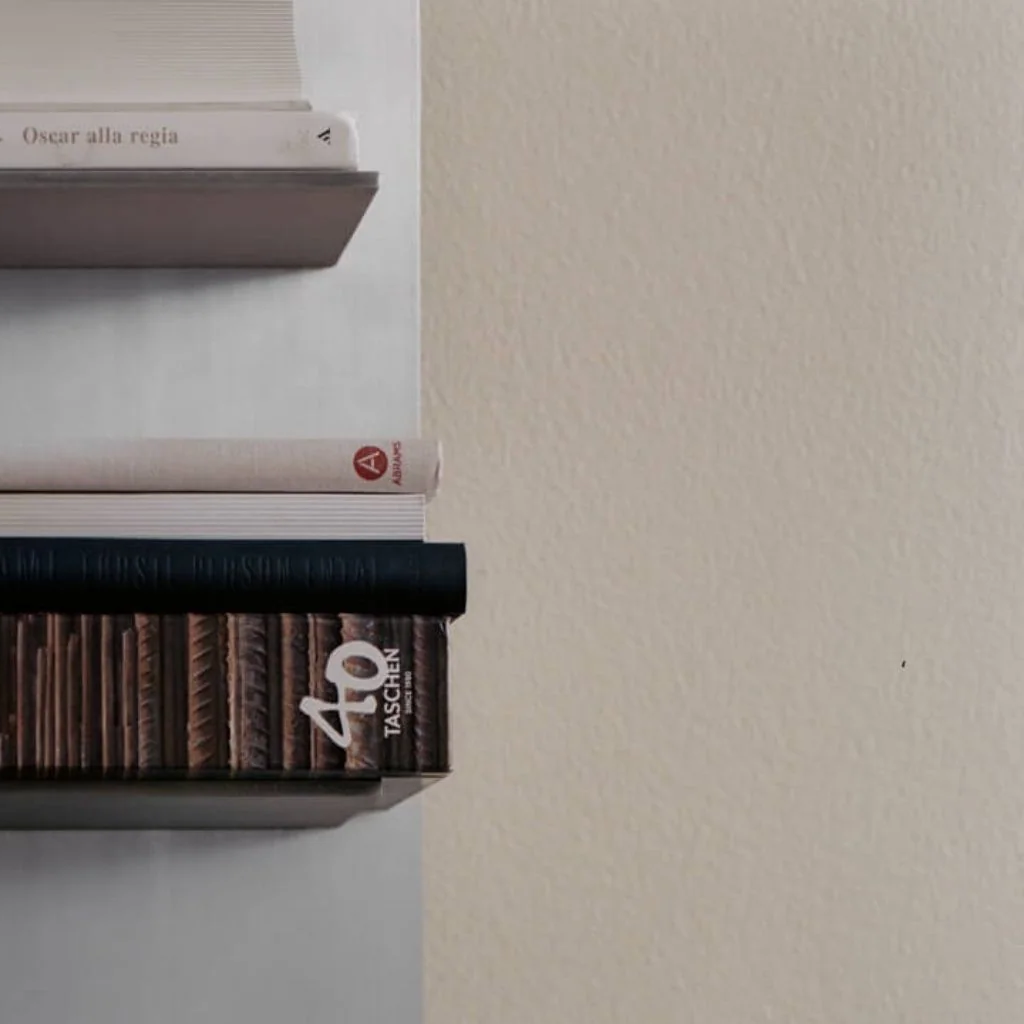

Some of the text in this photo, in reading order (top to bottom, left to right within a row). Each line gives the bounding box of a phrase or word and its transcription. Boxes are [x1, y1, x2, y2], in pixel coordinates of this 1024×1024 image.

[22, 126, 80, 145] Oscar
[86, 126, 122, 145] alla
[130, 126, 179, 148] regia
[391, 441, 402, 487] ABRAMS
[299, 640, 388, 749] 40
[383, 648, 401, 738] TASCHEN
